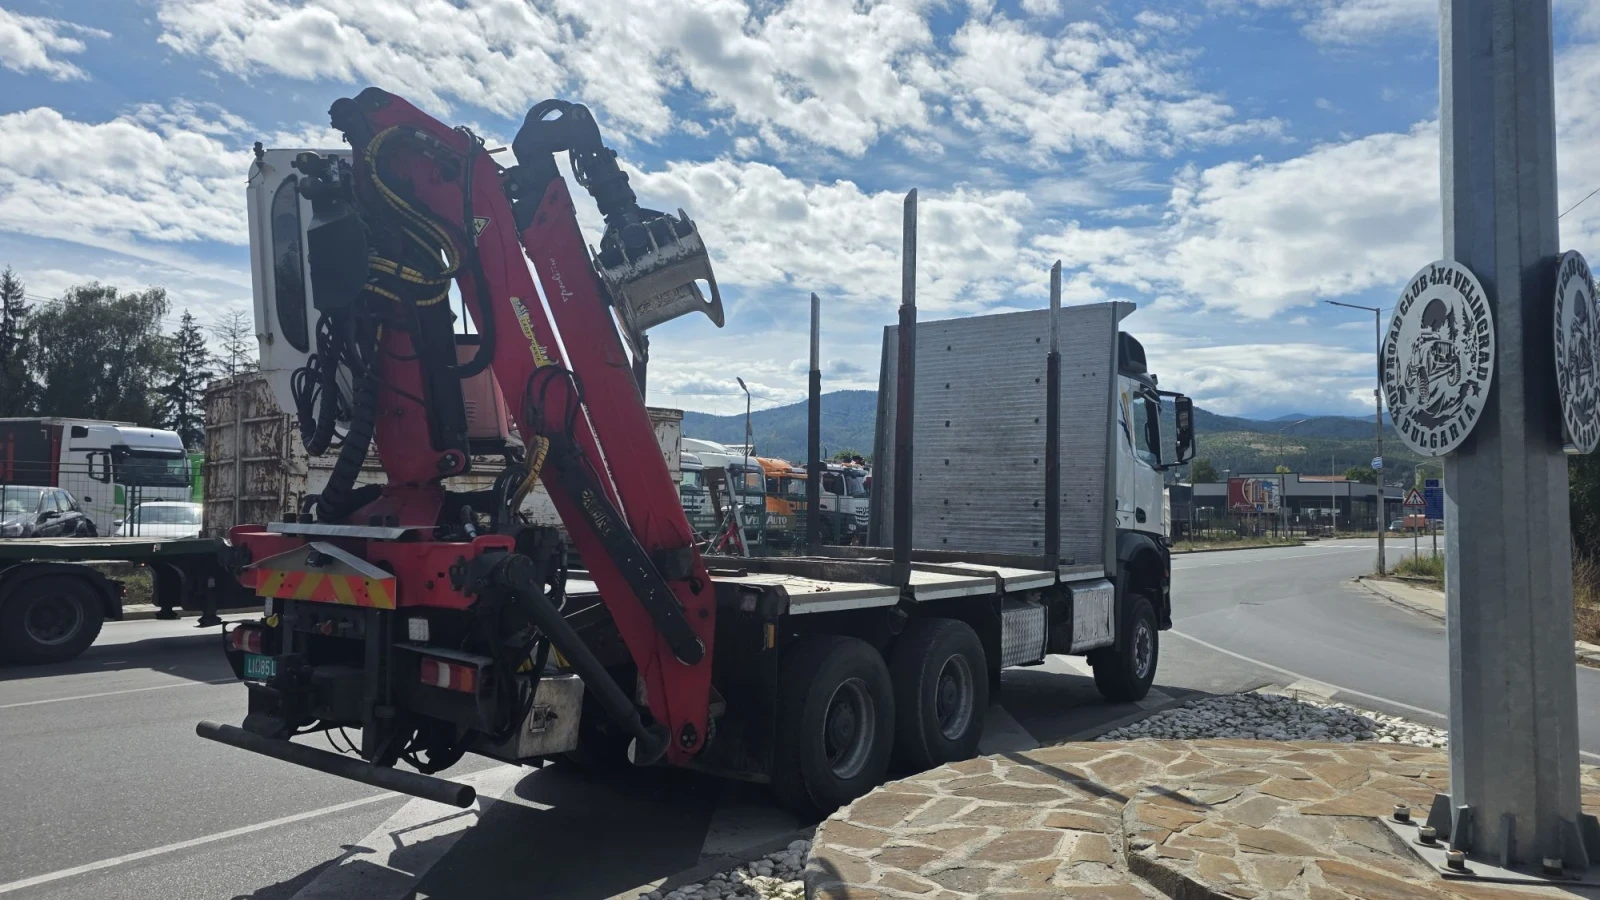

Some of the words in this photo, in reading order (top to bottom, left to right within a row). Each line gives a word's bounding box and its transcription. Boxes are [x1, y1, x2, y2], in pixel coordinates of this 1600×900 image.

[1400, 274, 1428, 316] CLUB
[1453, 270, 1490, 381] VELINGRAD
[1401, 404, 1477, 449] BULGARIA
[766, 515, 787, 525] AUTO
